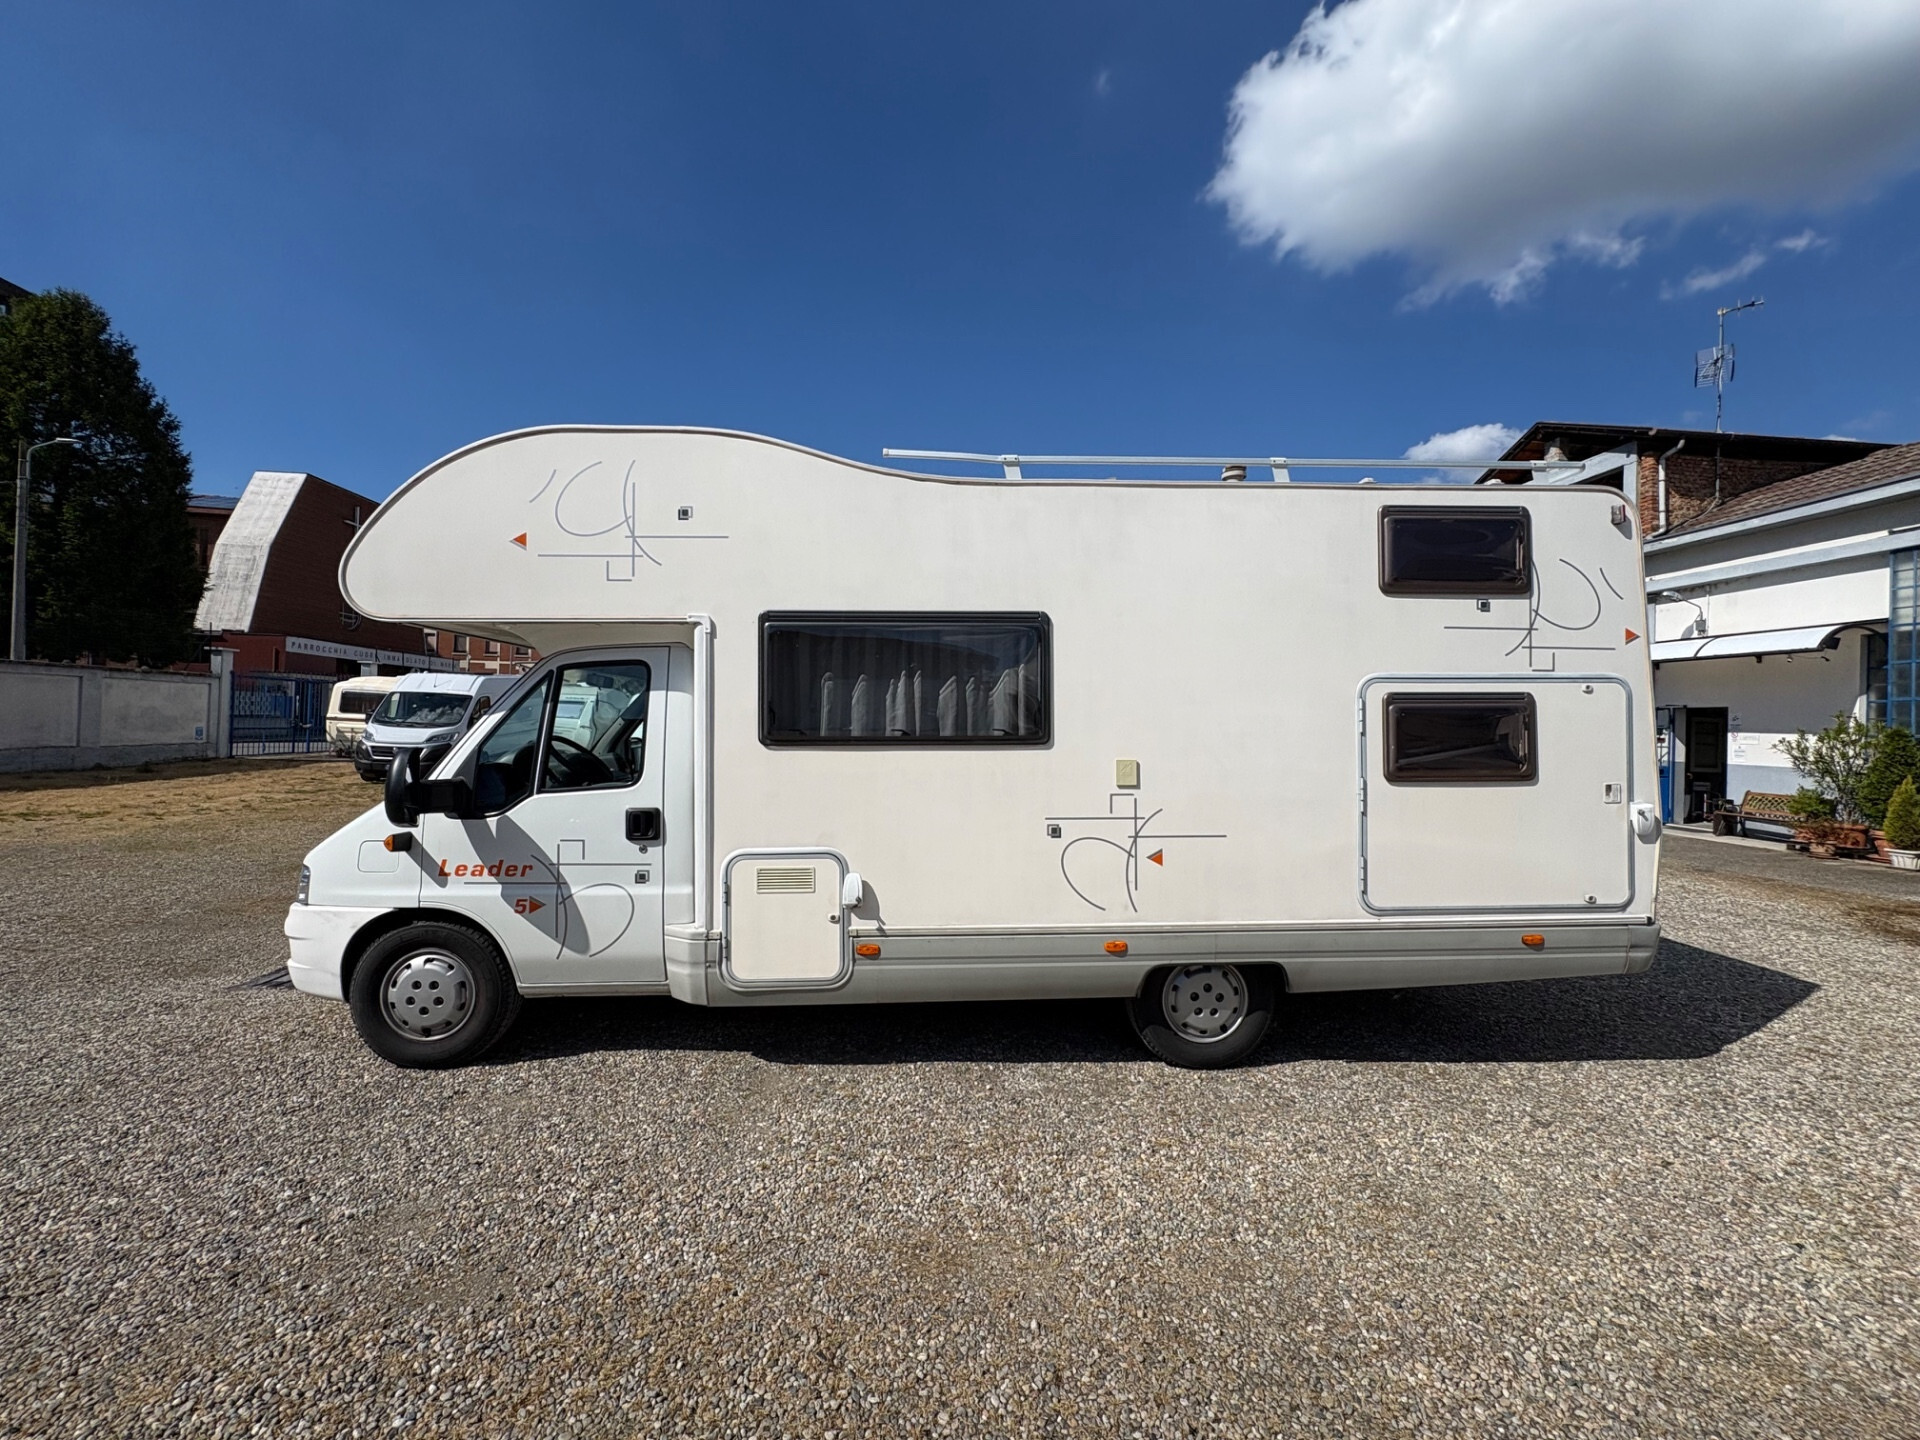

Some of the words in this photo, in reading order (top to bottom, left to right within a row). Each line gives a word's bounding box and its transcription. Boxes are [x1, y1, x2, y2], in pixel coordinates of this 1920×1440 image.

[291, 641, 347, 655] PARROCCHIA
[353, 650, 378, 659] CUOR
[383, 654, 426, 666] IMMAOLATO
[437, 858, 534, 878] Leader
[513, 898, 530, 914] 5
